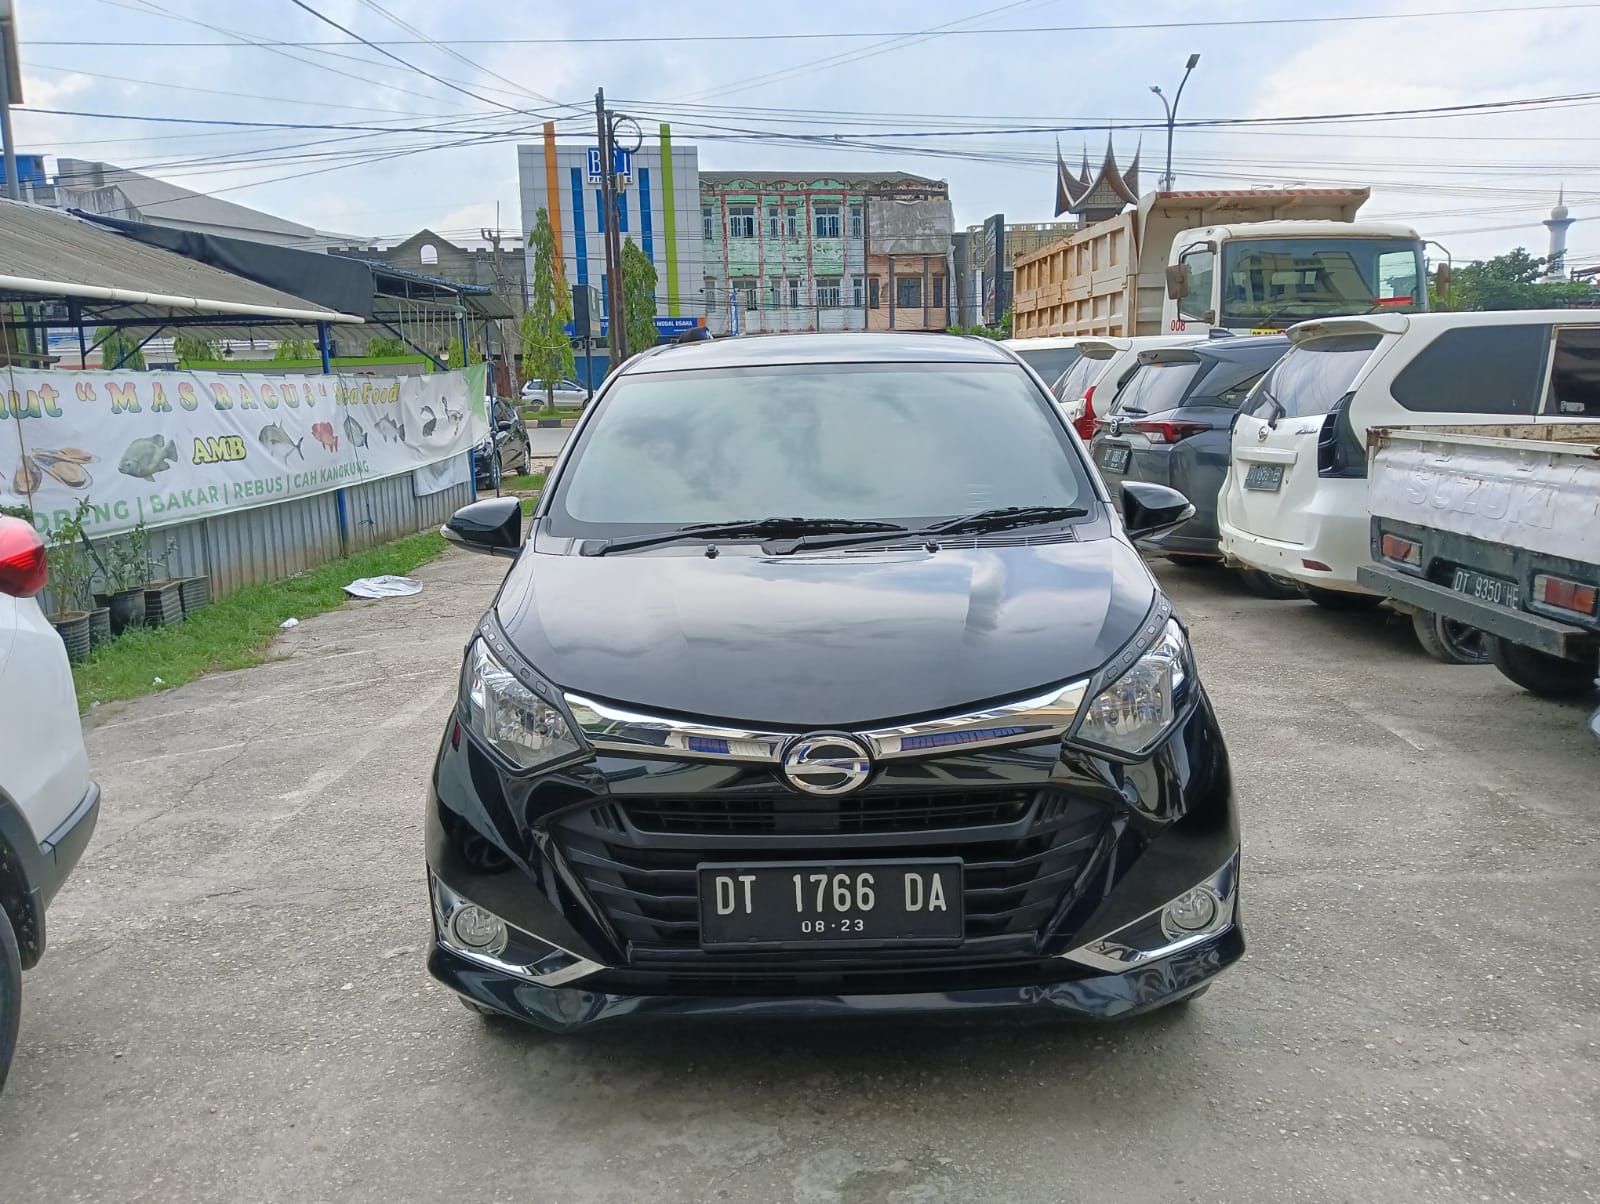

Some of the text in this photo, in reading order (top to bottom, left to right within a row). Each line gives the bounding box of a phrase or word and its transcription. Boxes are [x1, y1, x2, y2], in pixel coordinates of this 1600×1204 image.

[1170, 319, 1186, 332] 008
[361, 382, 401, 406] Food
[192, 435, 247, 466] AMB
[149, 484, 220, 515] BAKAR
[232, 474, 284, 500] REBUS
[294, 469, 317, 488] CAH
[1406, 467, 1561, 531] SUZUKI
[1454, 571, 1520, 610] DT 9350 HE
[715, 872, 948, 916] DT 1766 DA
